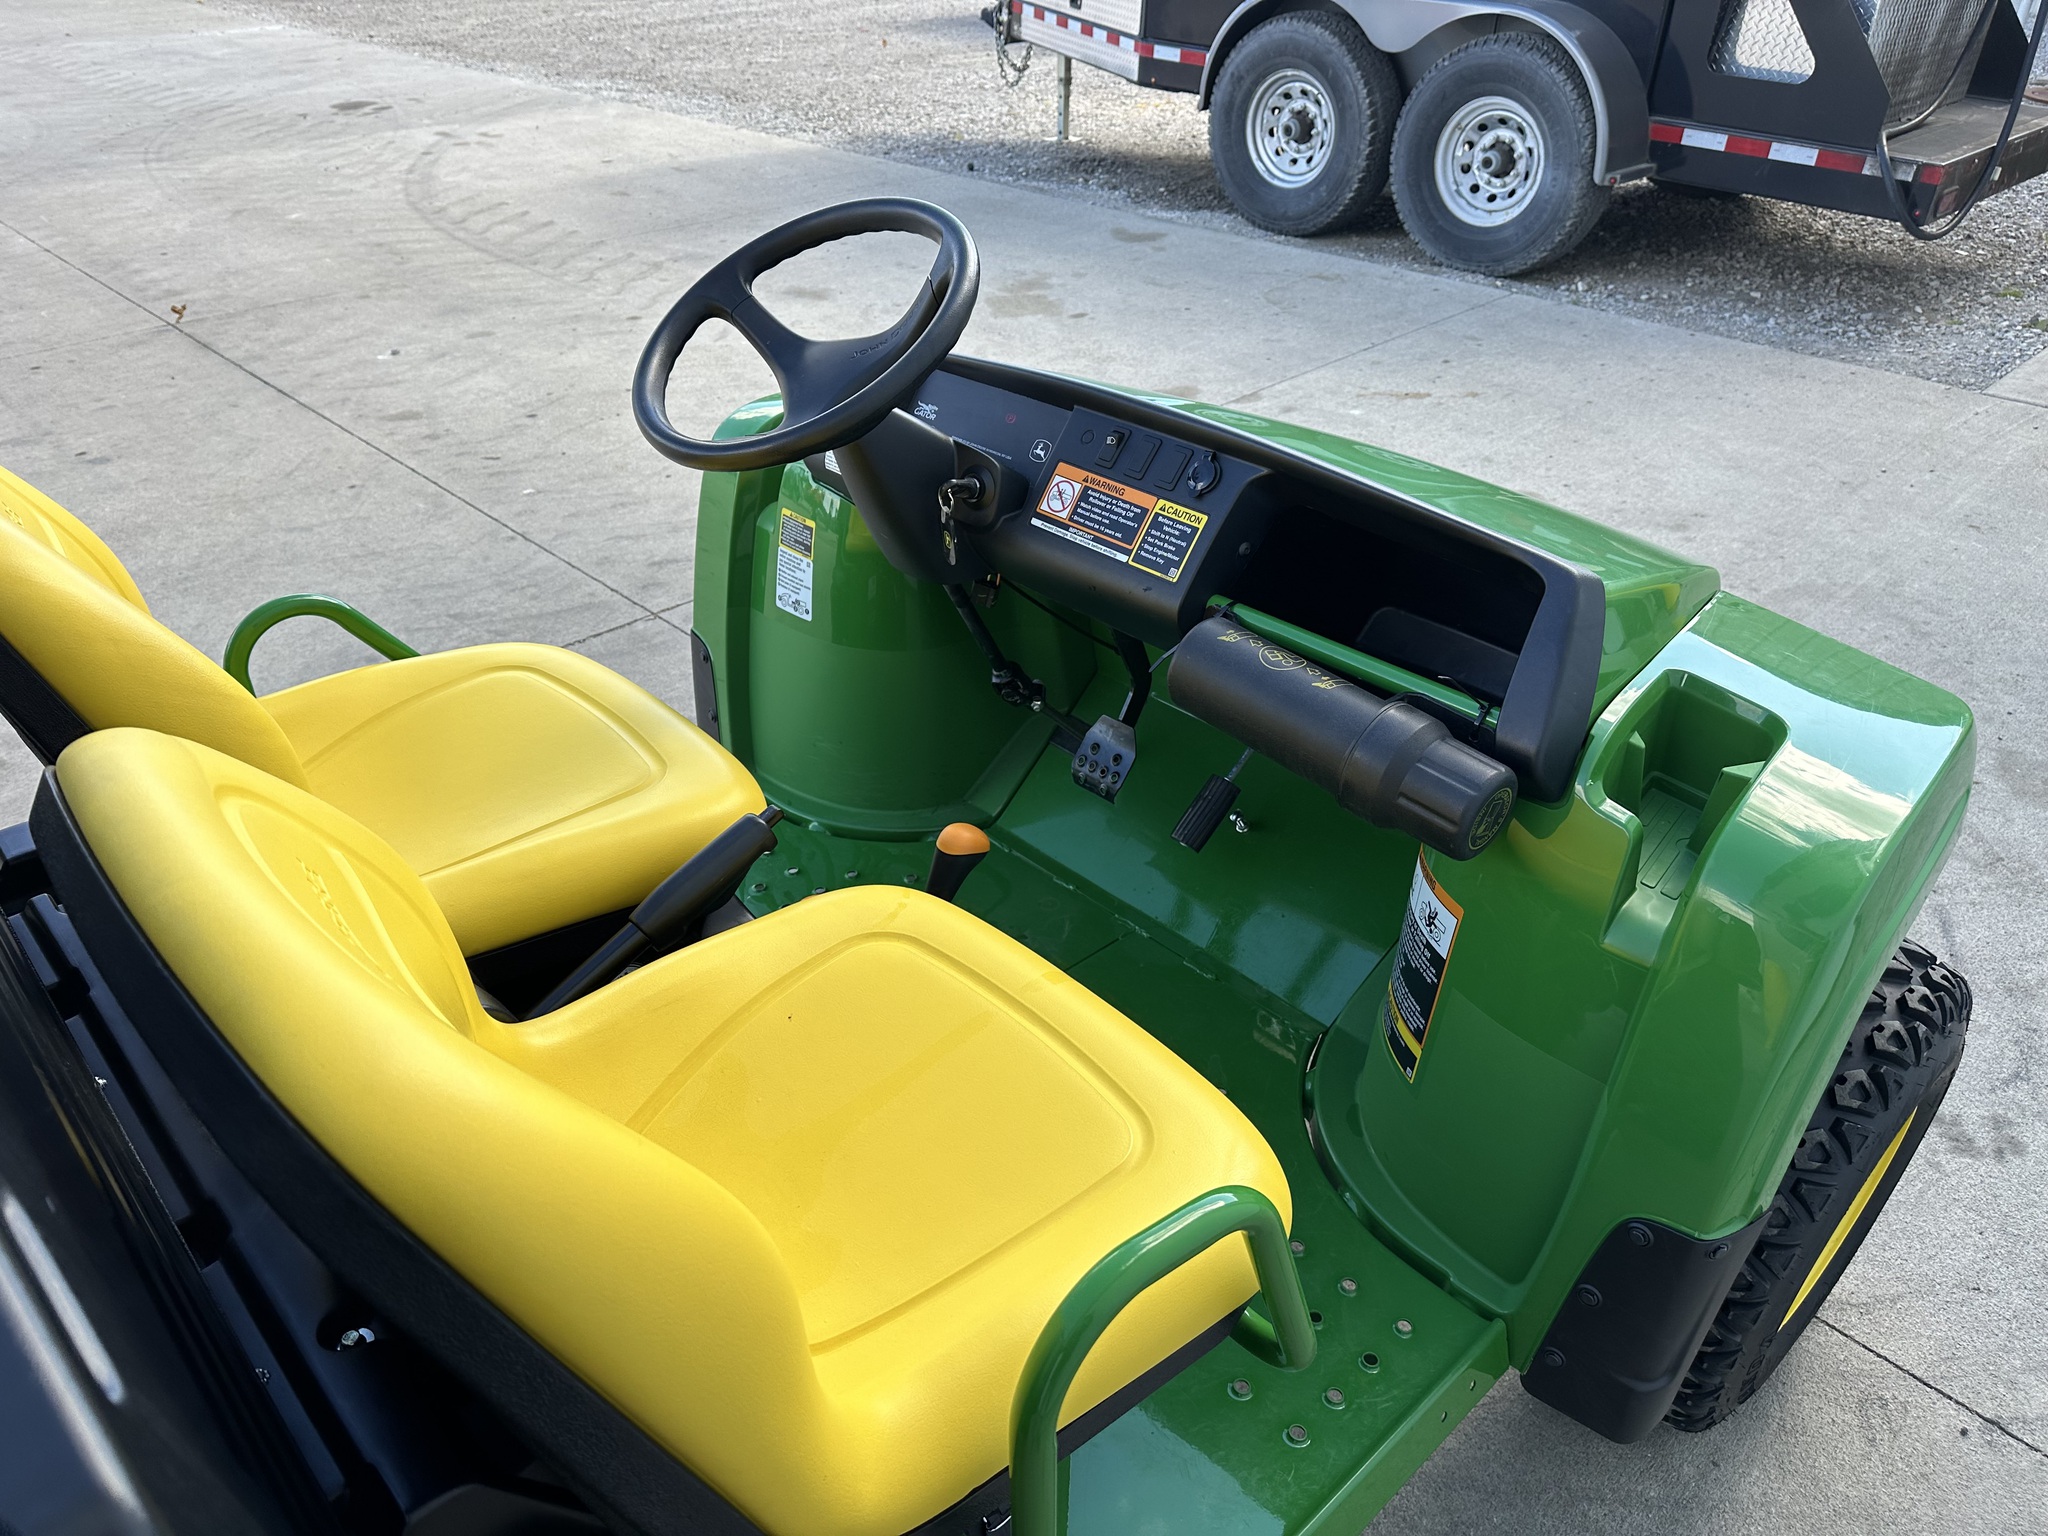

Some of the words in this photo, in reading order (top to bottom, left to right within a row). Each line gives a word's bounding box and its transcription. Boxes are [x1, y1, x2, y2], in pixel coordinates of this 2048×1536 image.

[914, 407, 936, 420] GATOR
[1089, 477, 1125, 496] WARNING
[1089, 497, 1106, 507] Rollover
[1112, 506, 1126, 516] Falling
[1100, 494, 1112, 503] Injury
[1117, 501, 1130, 509] Death
[1167, 506, 1203, 525] CAUTION
[1158, 516, 1173, 525] Before
[1173, 522, 1191, 534] Leaving
[1069, 527, 1094, 540] IMPORTANT
[1164, 543, 1176, 551] Brake
[1169, 537, 1186, 547] (Neutral)
[1140, 551, 1156, 560] Remove
